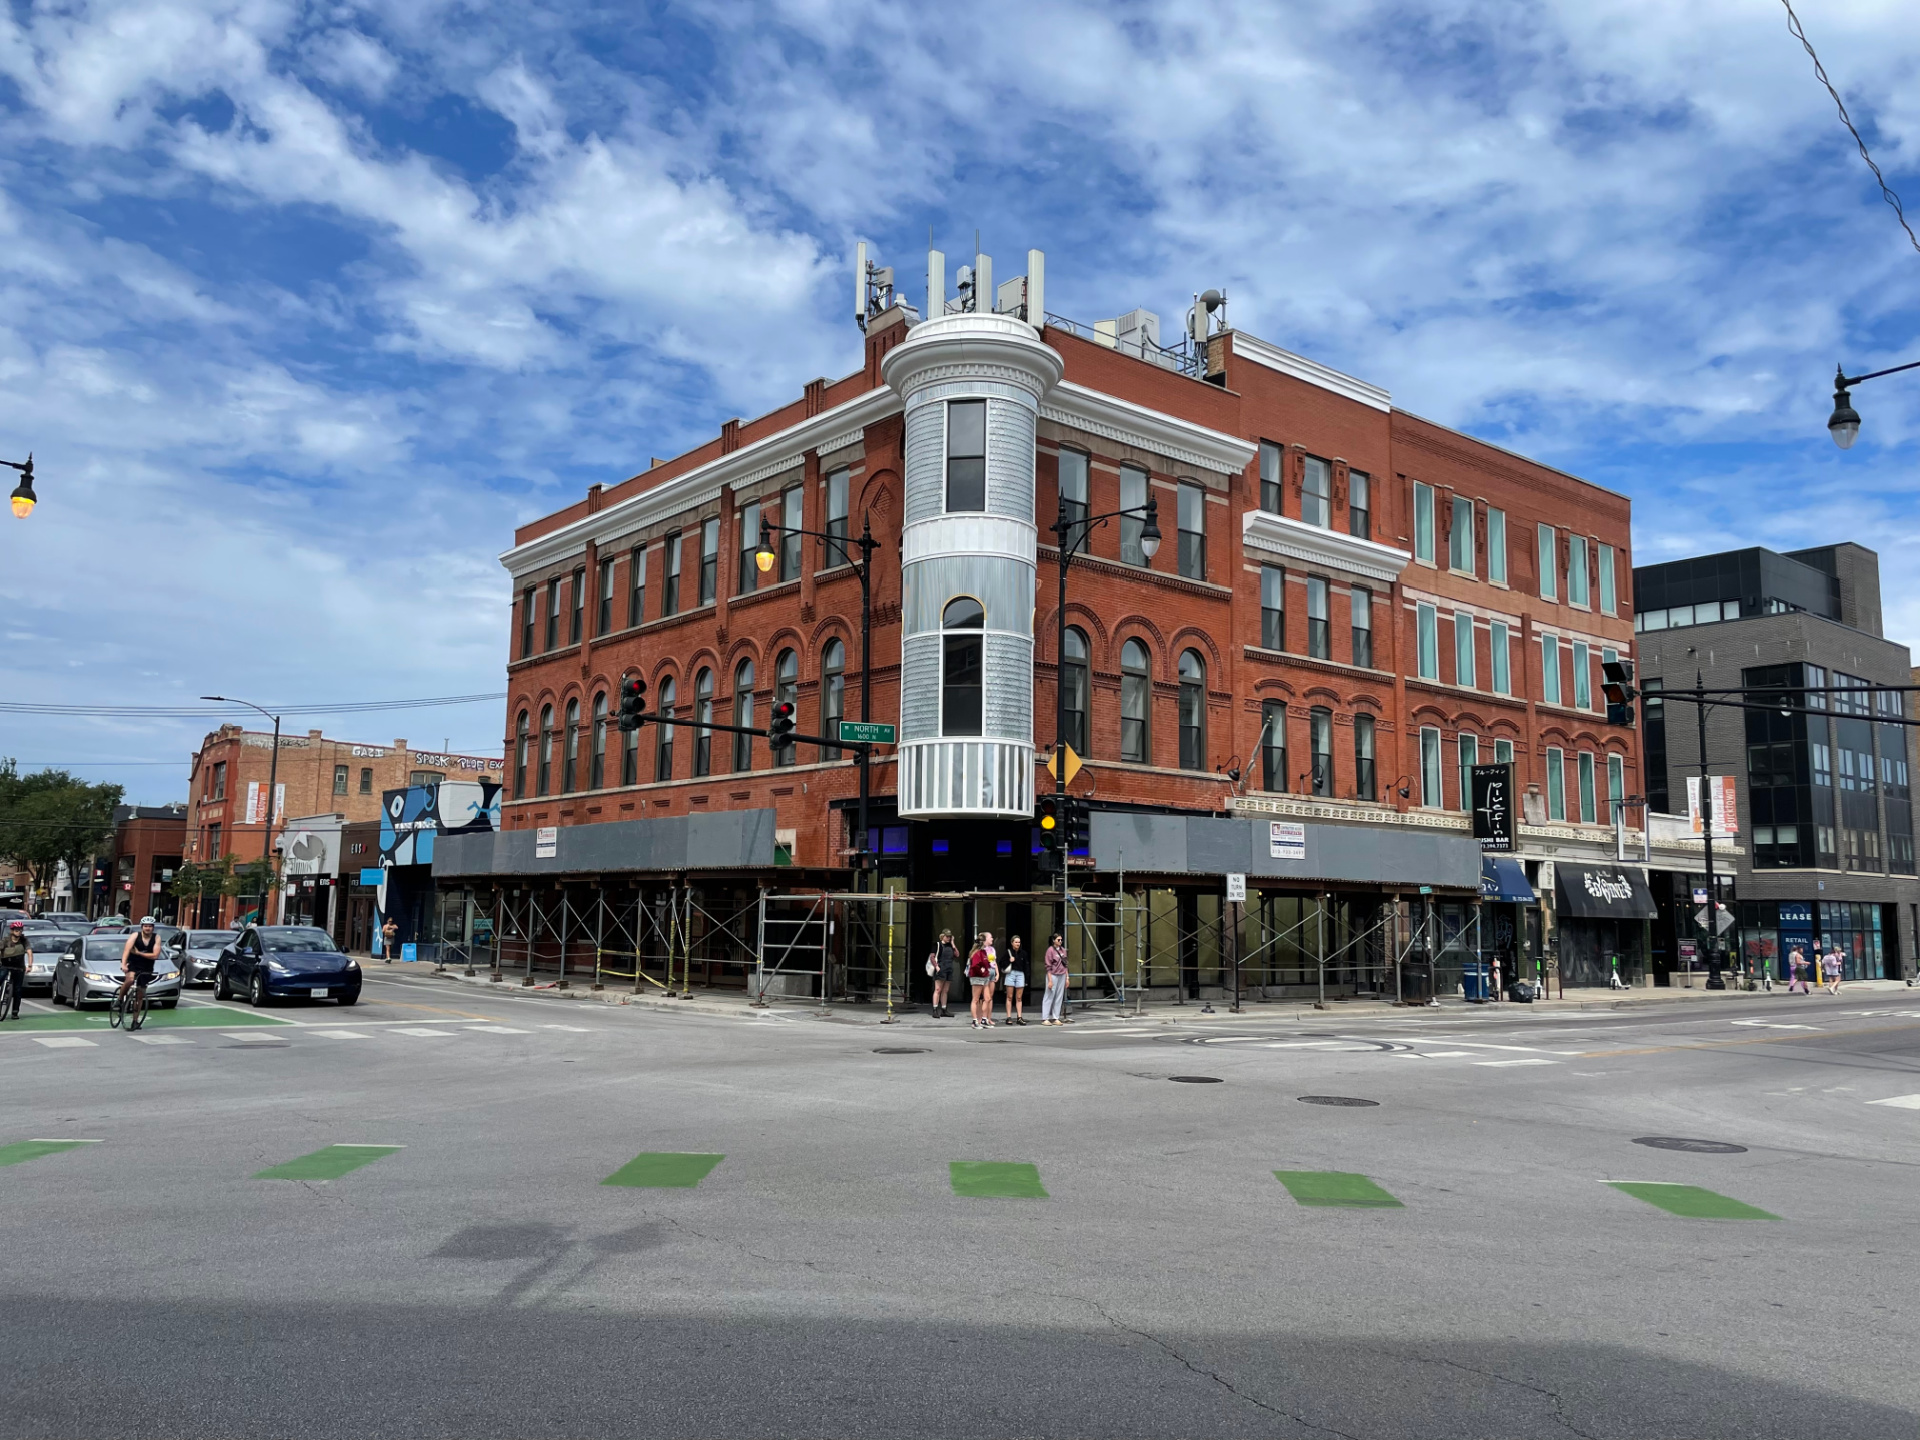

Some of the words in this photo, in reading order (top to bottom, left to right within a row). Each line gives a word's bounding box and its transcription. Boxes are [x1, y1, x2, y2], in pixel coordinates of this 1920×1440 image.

[854, 725, 879, 734] NORTH
[255, 791, 267, 821] Bucktown
[1725, 788, 1736, 828] Bucktown
